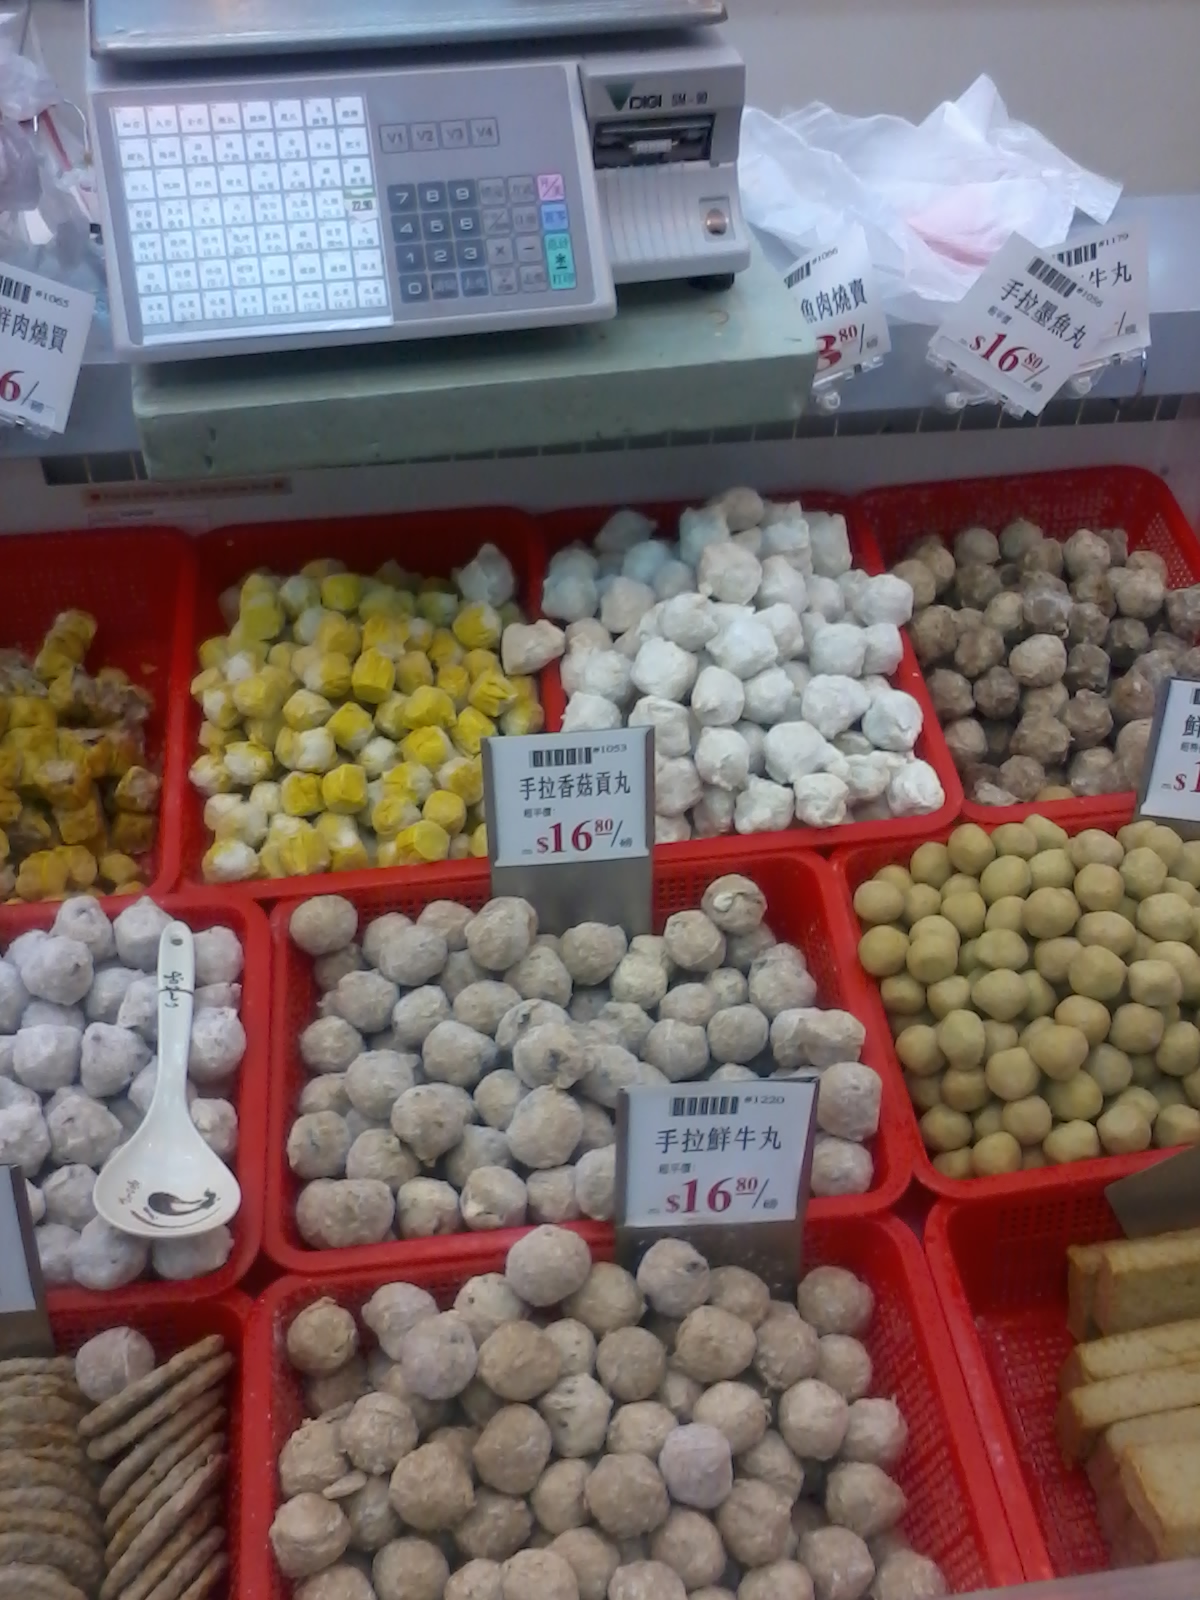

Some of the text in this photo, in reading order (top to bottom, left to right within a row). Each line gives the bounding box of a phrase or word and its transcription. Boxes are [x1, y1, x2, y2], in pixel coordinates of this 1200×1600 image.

[629, 94, 662, 110] DIGI
[386, 132, 404, 144] V1
[416, 130, 434, 142] V2
[475, 126, 493, 138] V4
[395, 192, 409, 205] 7
[426, 189, 440, 203] 8
[456, 187, 470, 201] 9
[399, 222, 414, 234] 4
[1099, 233, 1129, 247] #1179
[405, 252, 415, 264] 1
[433, 250, 448, 263] 2
[463, 247, 478, 260] 3
[407, 281, 422, 295] 0
[1000, 278, 1087, 350] 手拉墨魚丸
[838, 324, 858, 343] 80
[593, 743, 628, 755] #1053
[519, 770, 631, 801] 手拉香菇貢丸
[536, 819, 593, 855] $16
[594, 818, 614, 835] 80
[744, 1095, 785, 1104] #1220
[655, 1125, 782, 1154] 手拉鮮牛丸
[665, 1176, 733, 1214] $16
[735, 1176, 758, 1195] 80
